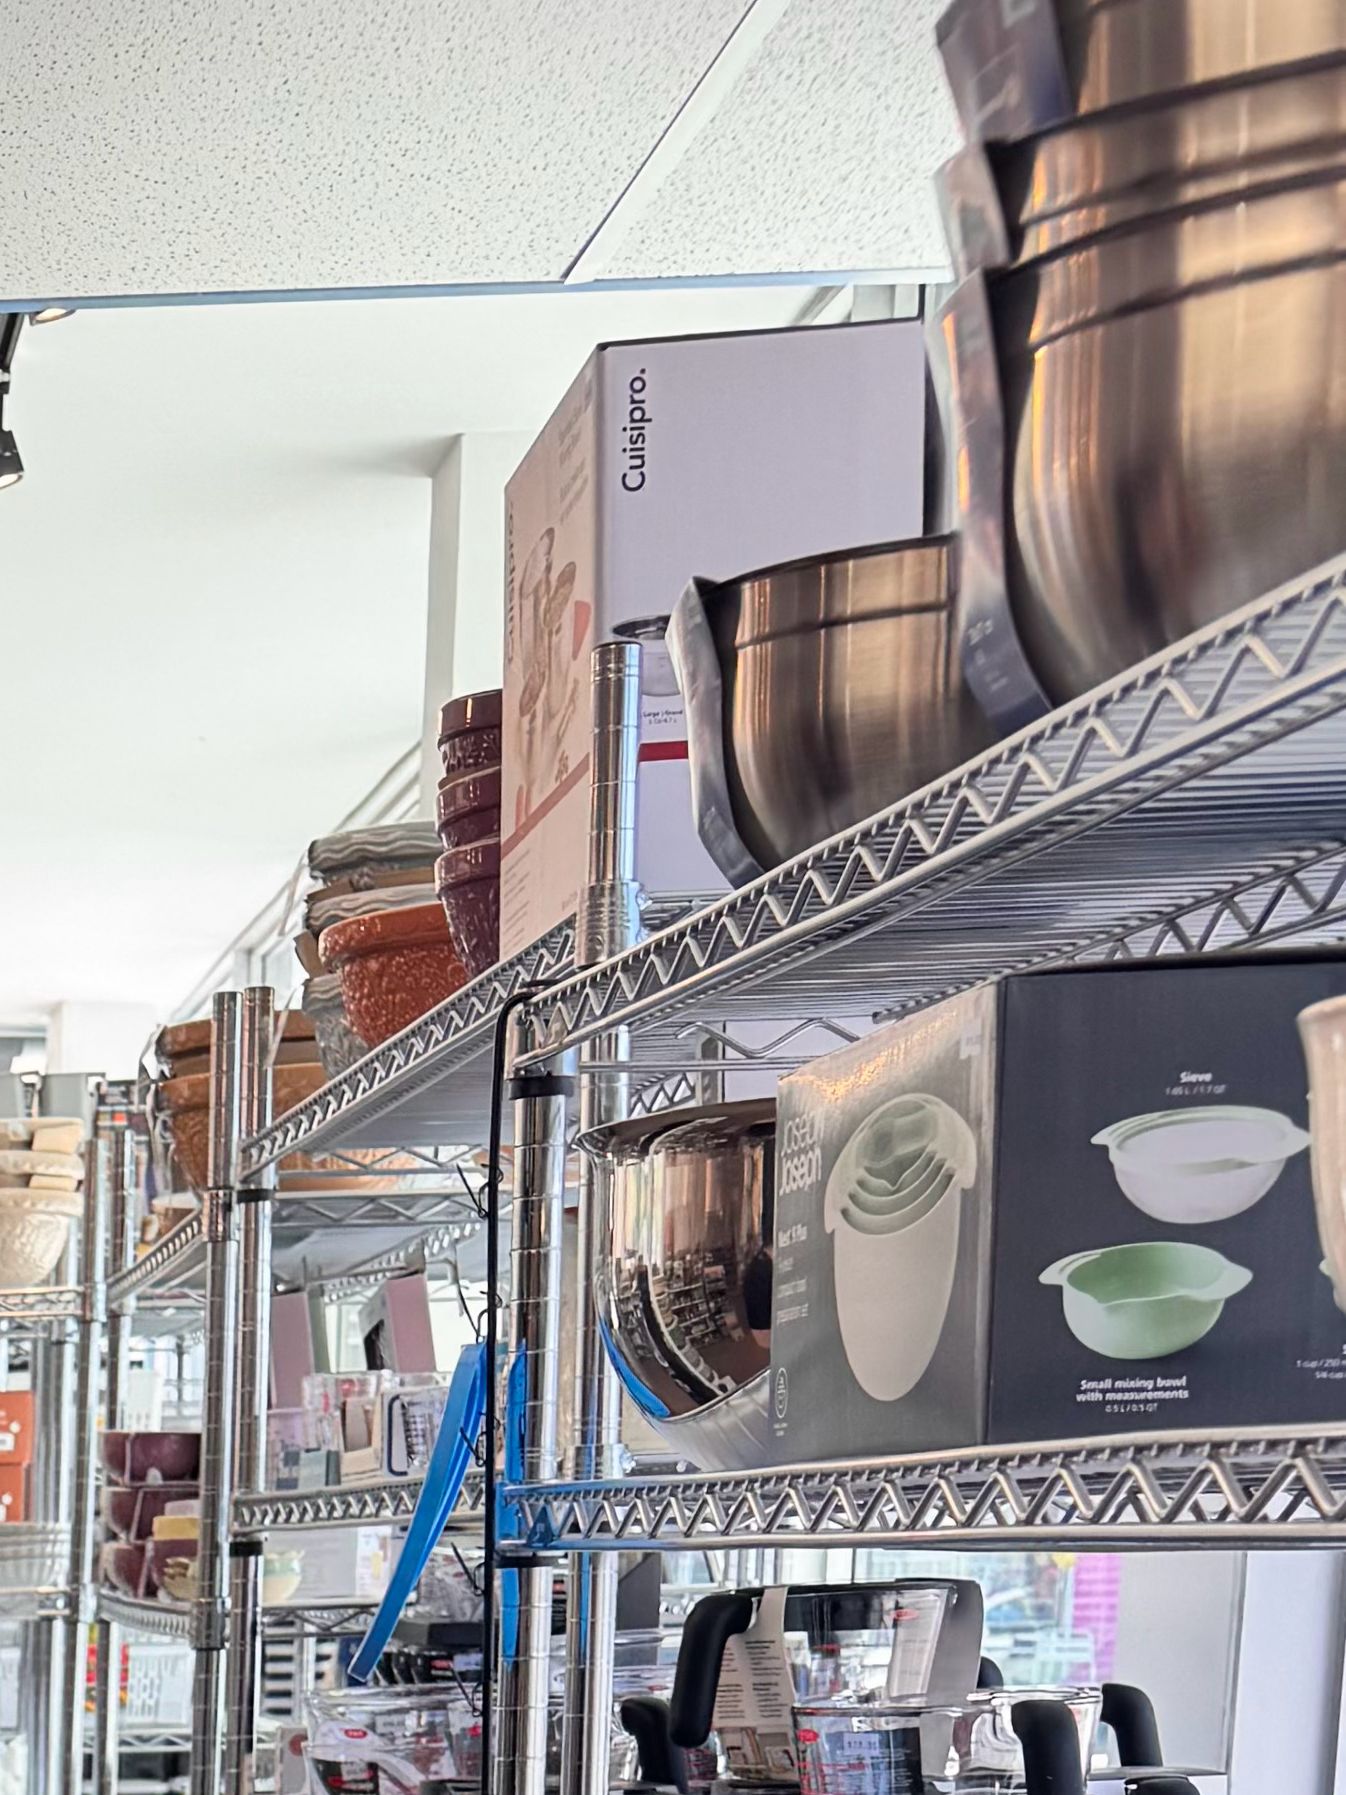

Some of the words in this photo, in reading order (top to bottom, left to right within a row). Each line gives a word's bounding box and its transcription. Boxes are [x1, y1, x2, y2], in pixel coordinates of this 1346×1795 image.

[621, 367, 653, 493] Cuisipro.
[1180, 1071, 1213, 1083] Sieve
[779, 1146, 822, 1196] Joseph
[1080, 1378, 1112, 1390] Small
[1114, 1377, 1154, 1390] mixing
[1156, 1375, 1187, 1388] bowl
[1076, 1390, 1103, 1402] with
[1105, 1389, 1189, 1401] measurements
